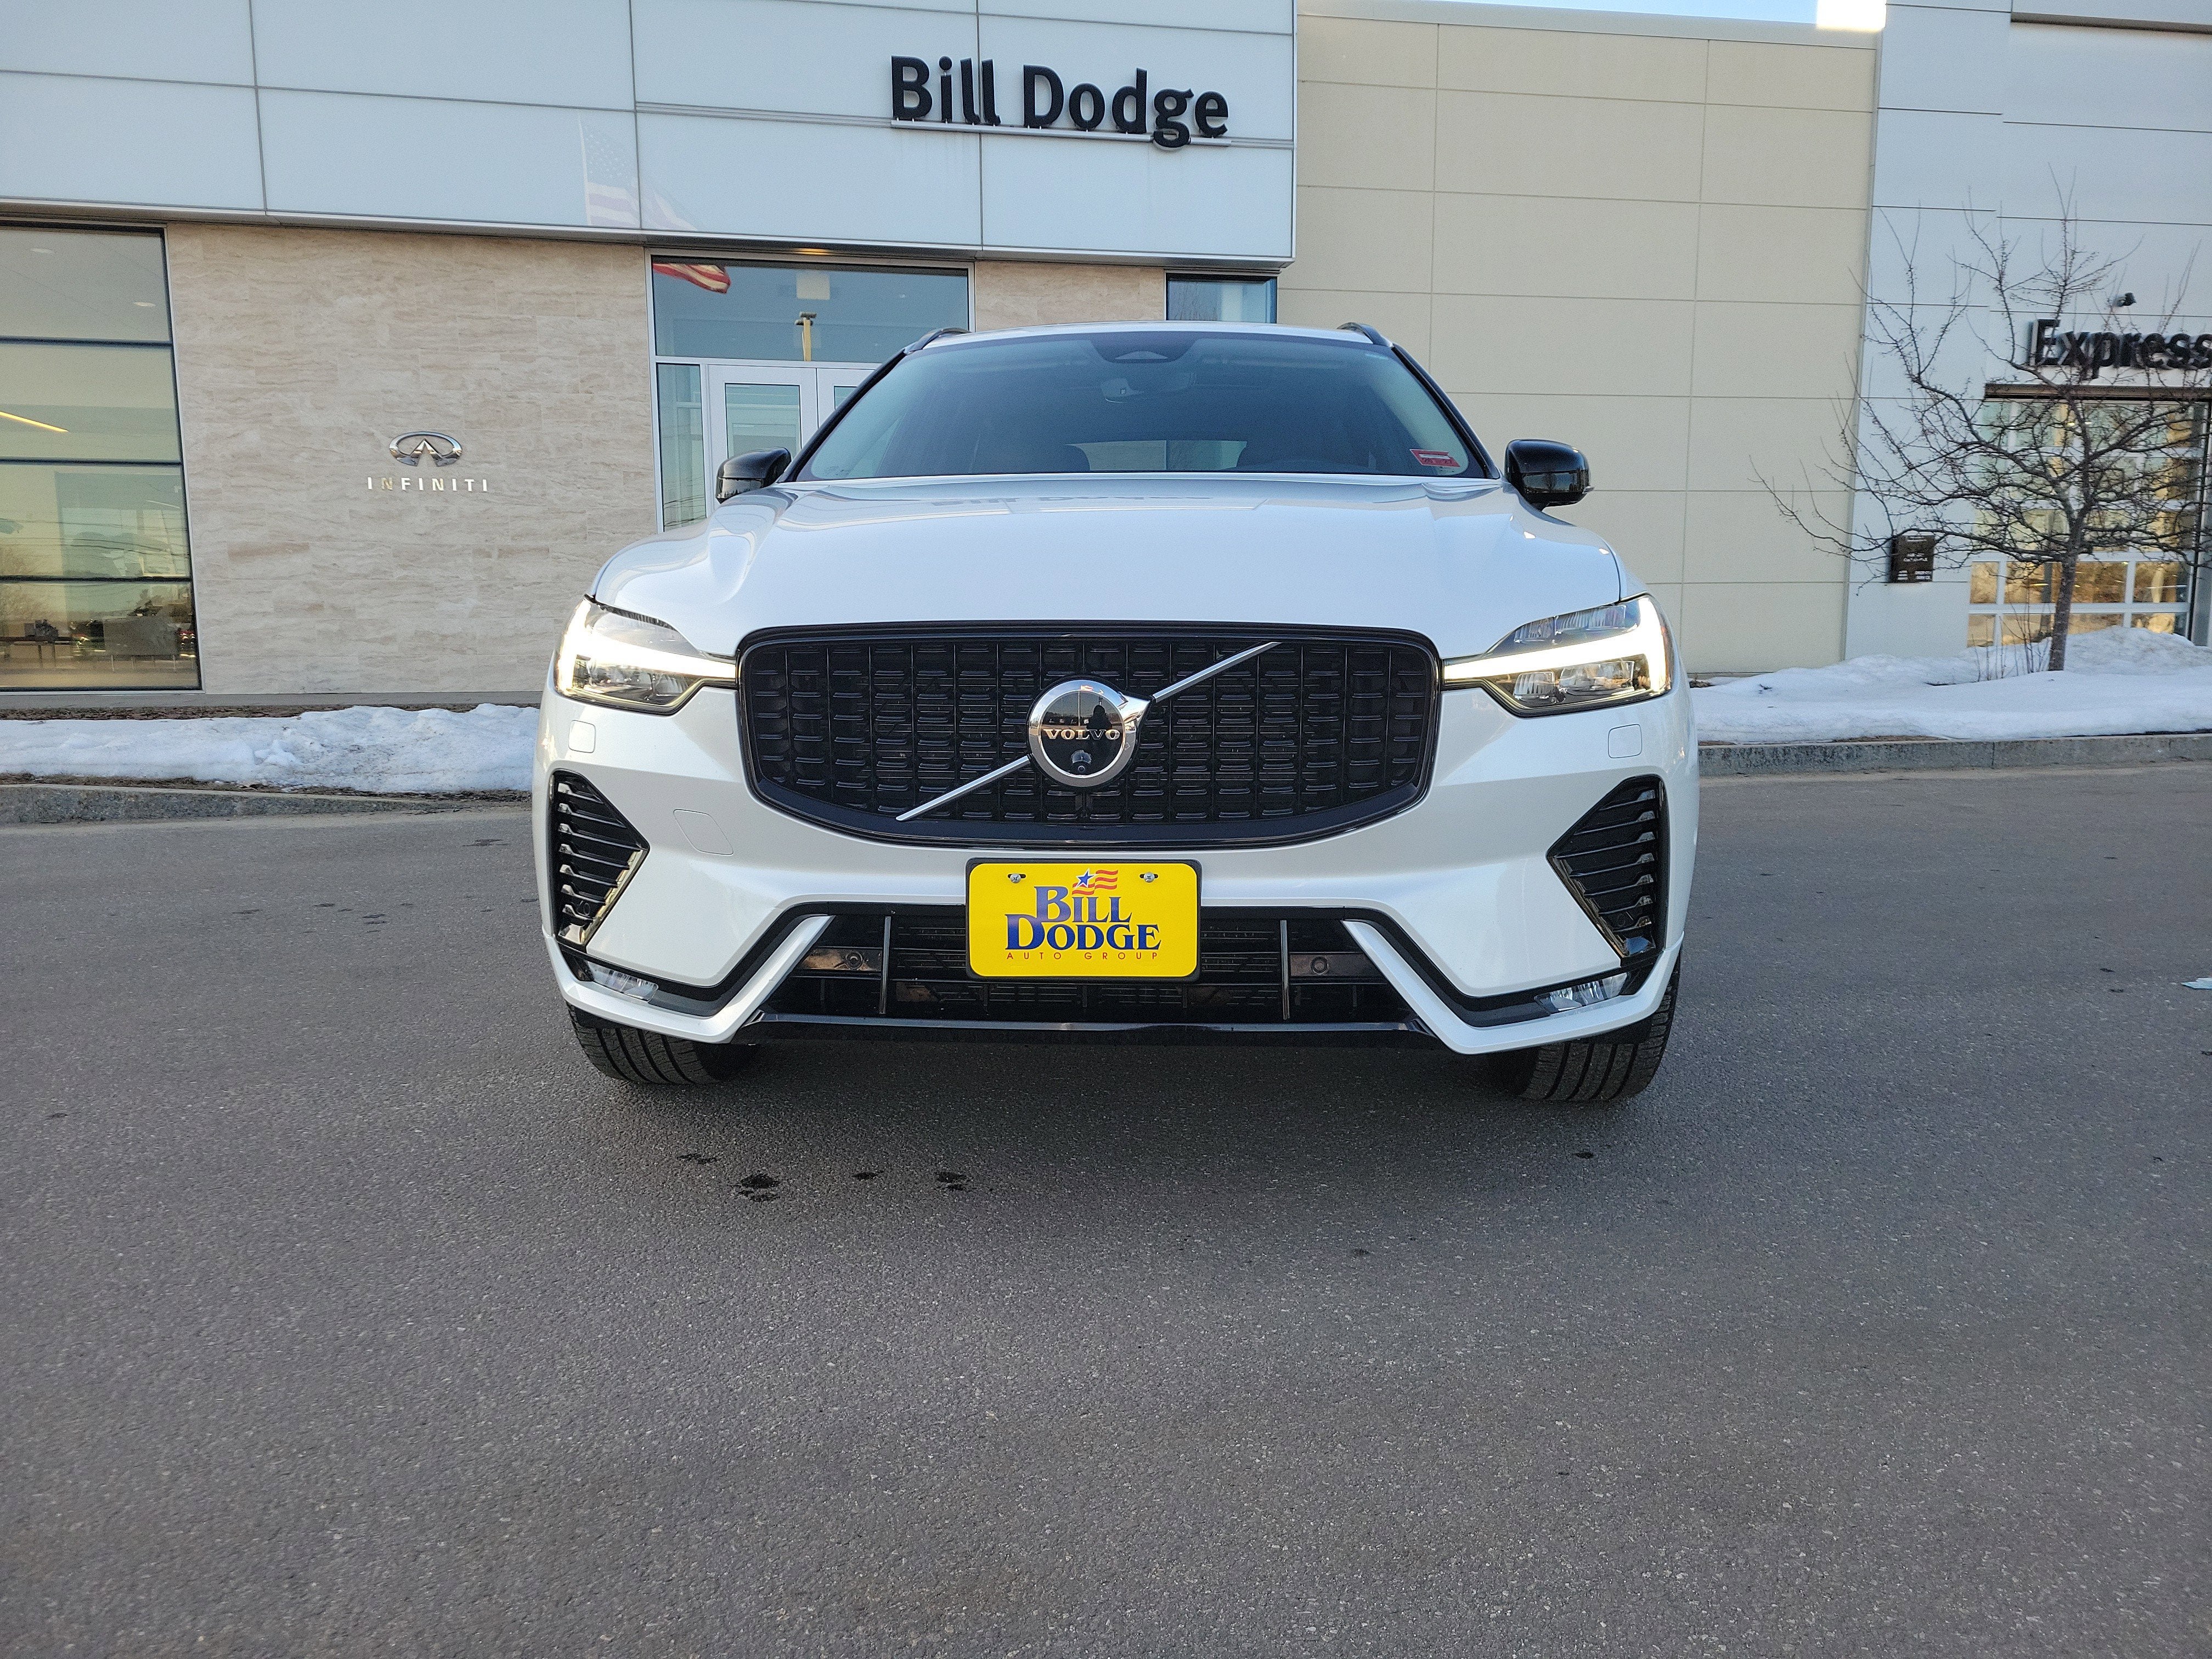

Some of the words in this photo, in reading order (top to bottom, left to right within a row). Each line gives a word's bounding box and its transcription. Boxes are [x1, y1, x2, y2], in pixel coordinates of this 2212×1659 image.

[891, 55, 1001, 125] Bill
[1023, 64, 1229, 148] Dodge
[2028, 319, 2212, 379] Express
[367, 477, 488, 492] INFINITI
[1043, 729, 1120, 740] VOLVO
[1034, 885, 1132, 923] BILL
[1005, 913, 1161, 950] DODGE
